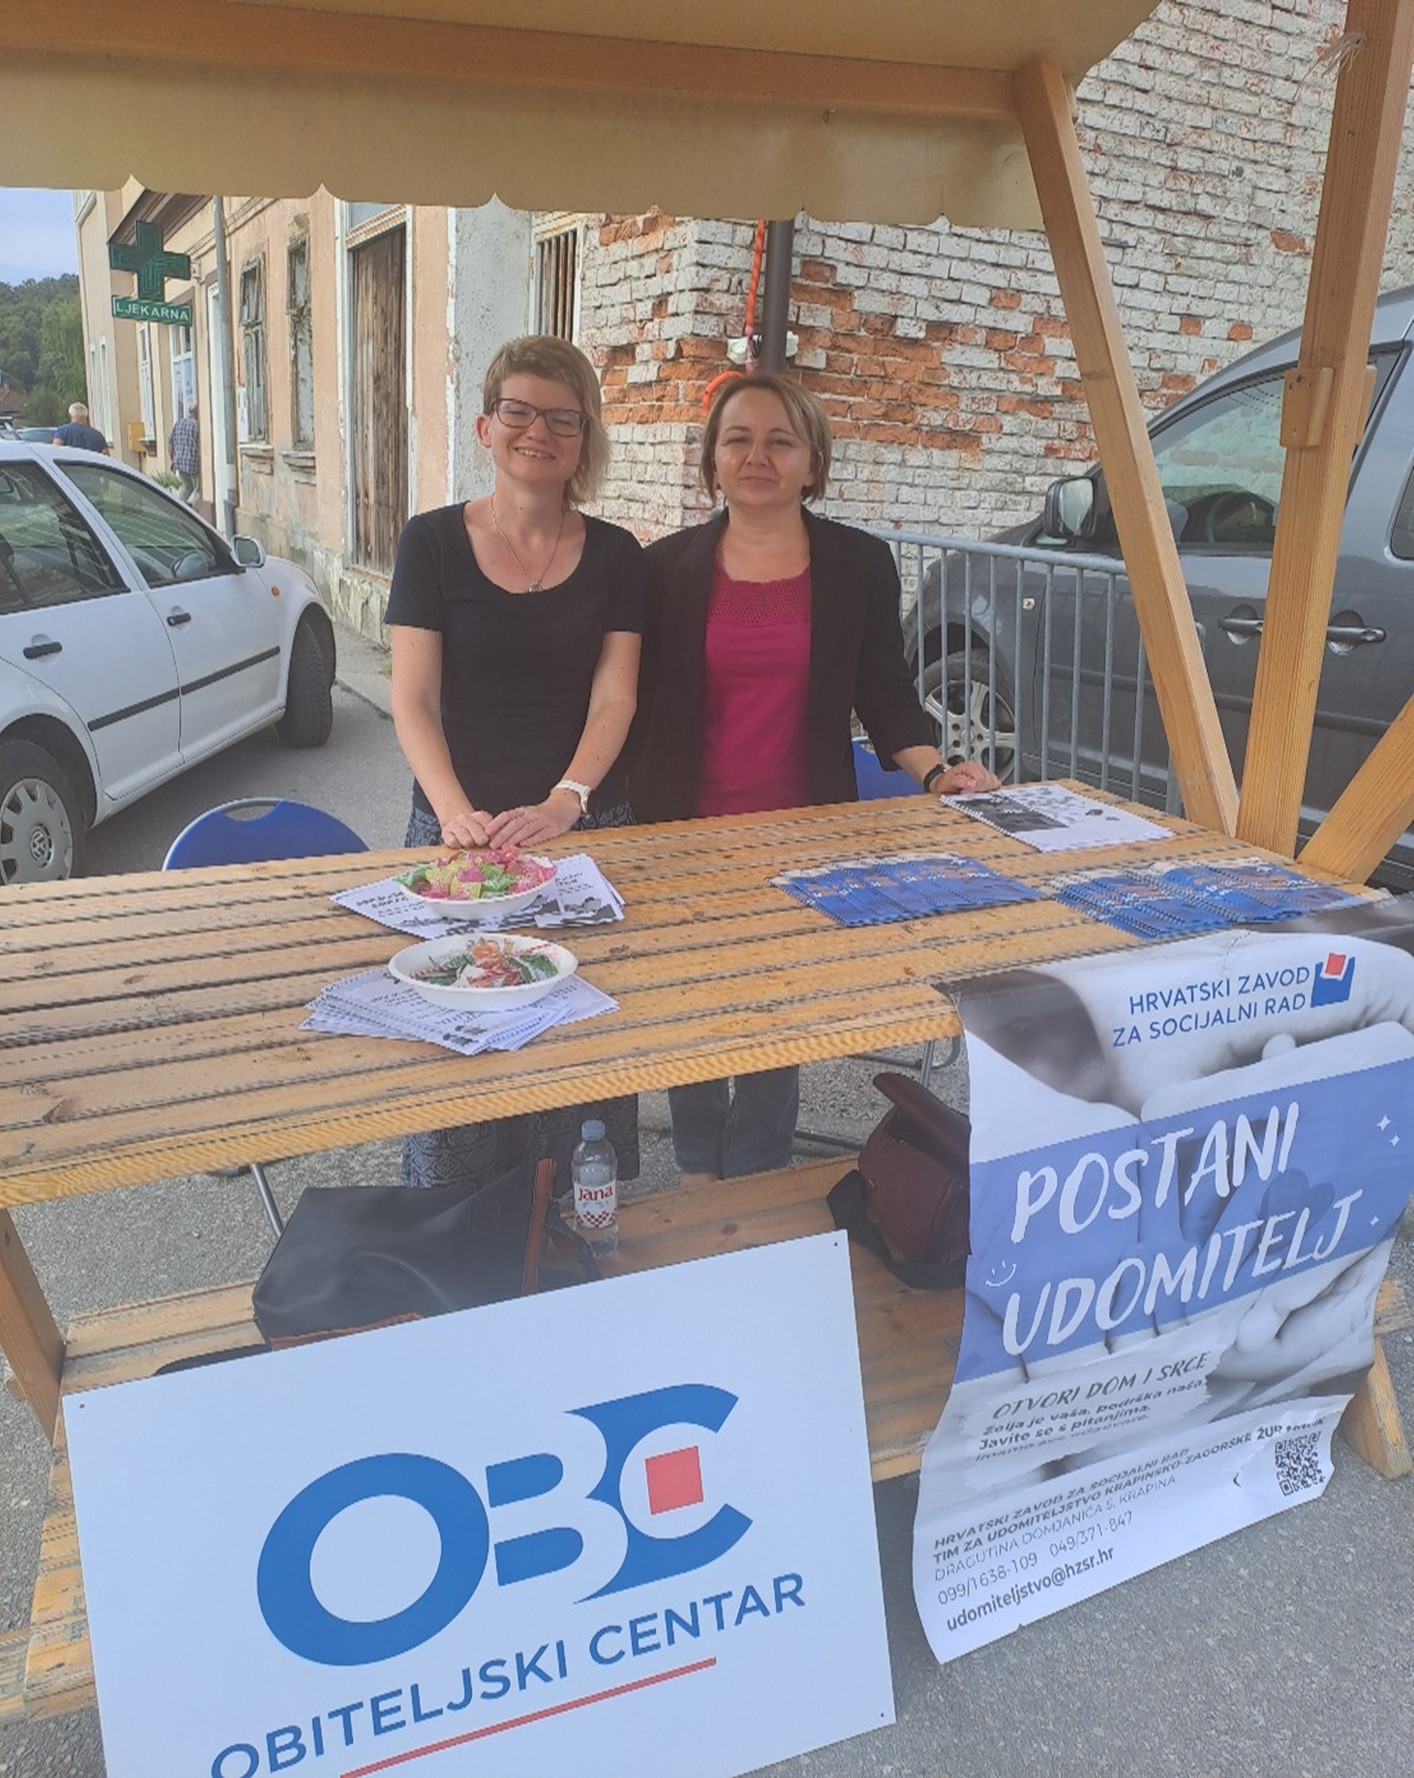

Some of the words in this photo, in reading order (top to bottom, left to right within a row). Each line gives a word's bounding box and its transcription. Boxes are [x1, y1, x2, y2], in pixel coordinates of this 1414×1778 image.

[115, 302, 190, 321] LJEKARNA
[1112, 1025, 1142, 1047] ZA
[1149, 1001, 1258, 1040] SOCIJALNI
[1263, 992, 1307, 1017] RAD
[1129, 978, 1231, 1015] HRVATSKI
[1237, 966, 1310, 995] ZAVOD
[577, 1185, 613, 1201] Jana
[1010, 1101, 1300, 1244] POSTANI
[1002, 1188, 1364, 1356] UDOMITELJ
[992, 1386, 1081, 1420] OTVORI
[1086, 1372, 1137, 1399] DOM
[1142, 1367, 1153, 1385] I
[1157, 1351, 1211, 1382] SRCE
[933, 1545, 960, 1564] TIM
[963, 1537, 983, 1552] ZA
[987, 1491, 1101, 1542] UDOMITELJSTVO
[1105, 1431, 1253, 1496] KRAPINSKO-ZAGORSKE
[934, 1514, 1009, 1549] HRVATSKI
[1013, 1494, 1063, 1520] ZAVOD
[1067, 1486, 1085, 1499] ZA
[1089, 1459, 1158, 1490] SOCIJALNI
[935, 1538, 1019, 1581] DRAGUTINA
[1119, 1474, 1176, 1504] KRAPINA
[937, 1551, 1039, 1605] 099/1638-109
[1049, 1510, 1132, 1557] 049/371-847
[946, 1546, 1115, 1631] udomiteljstvo@hzsr.hr
[210, 1639, 568, 1778] OBITELJSKI
[589, 1572, 807, 1666] CENTAR
